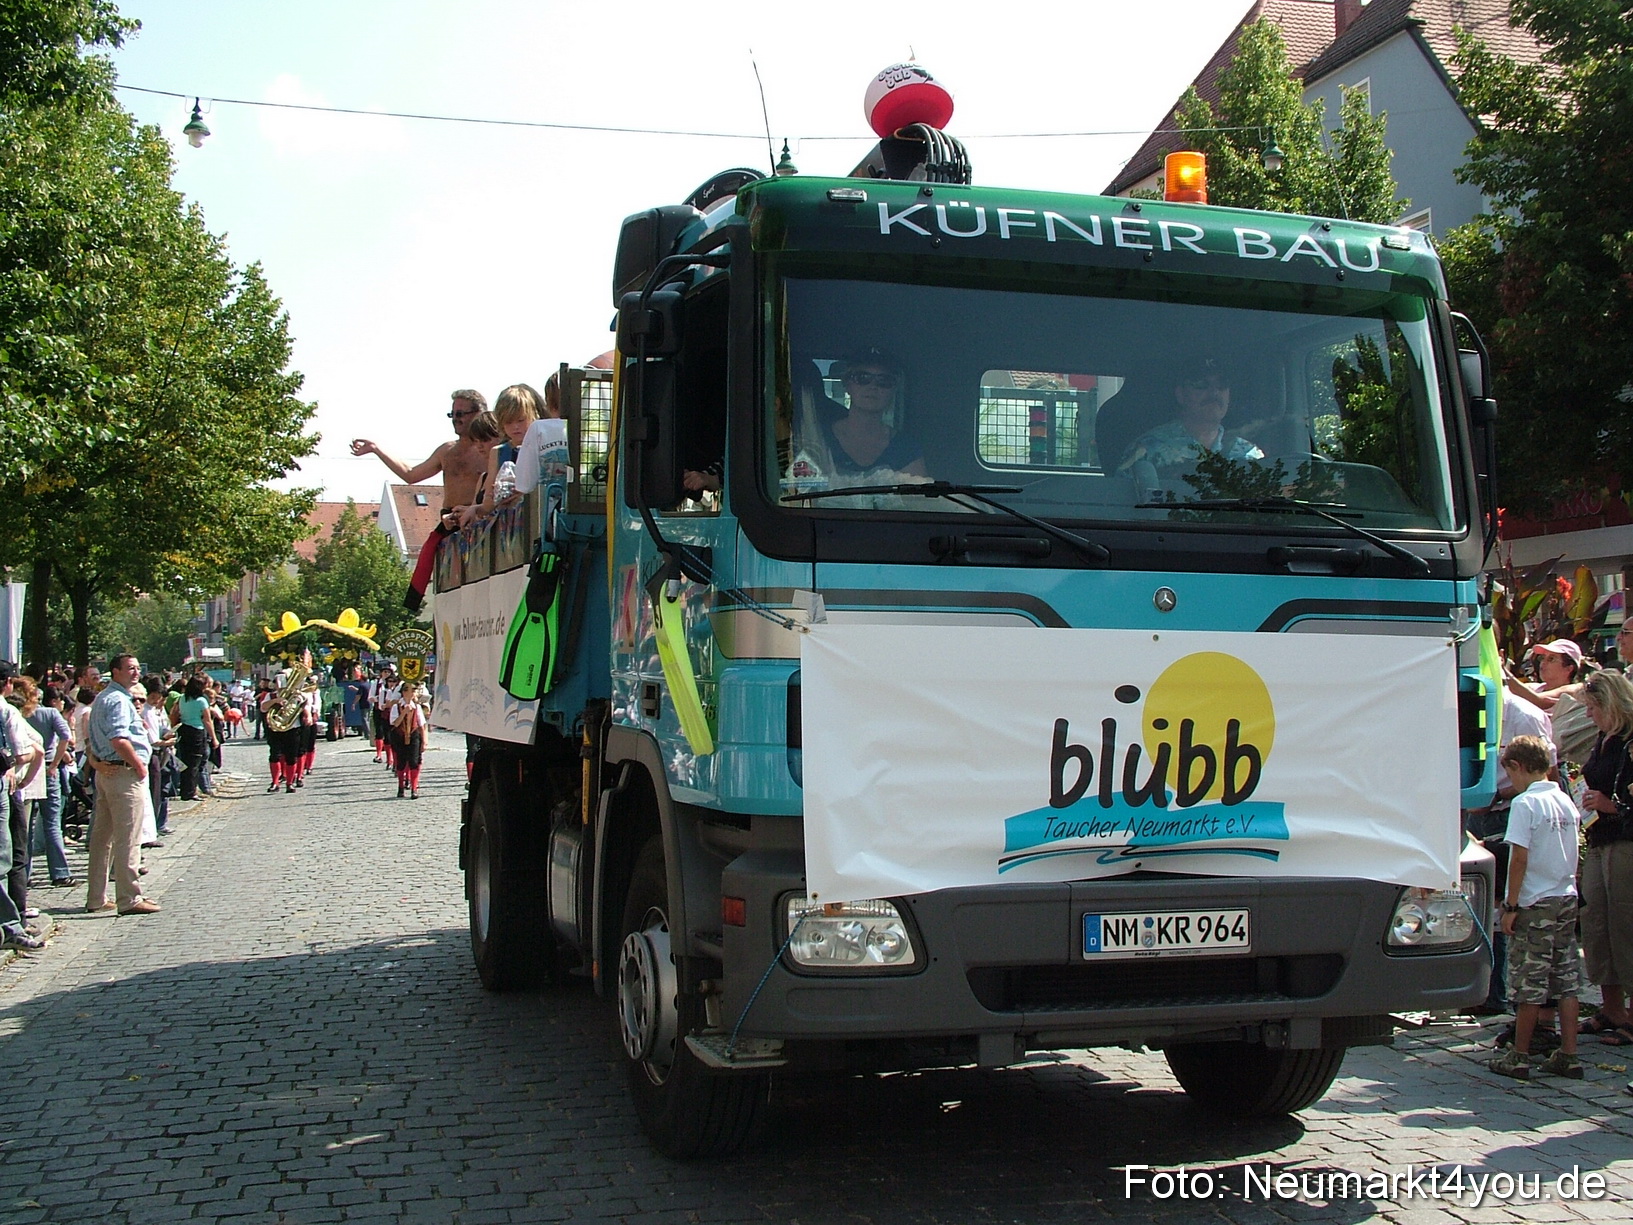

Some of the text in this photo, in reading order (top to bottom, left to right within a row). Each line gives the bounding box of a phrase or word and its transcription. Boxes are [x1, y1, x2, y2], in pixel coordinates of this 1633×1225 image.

[877, 200, 1380, 273] KÜFNER BAU
[396, 641, 427, 655] Pilsach
[1044, 813, 1258, 839] Taucher Neumarkt e.V.
[1090, 937, 1097, 946] D
[1103, 914, 1246, 947] NM KR 964
